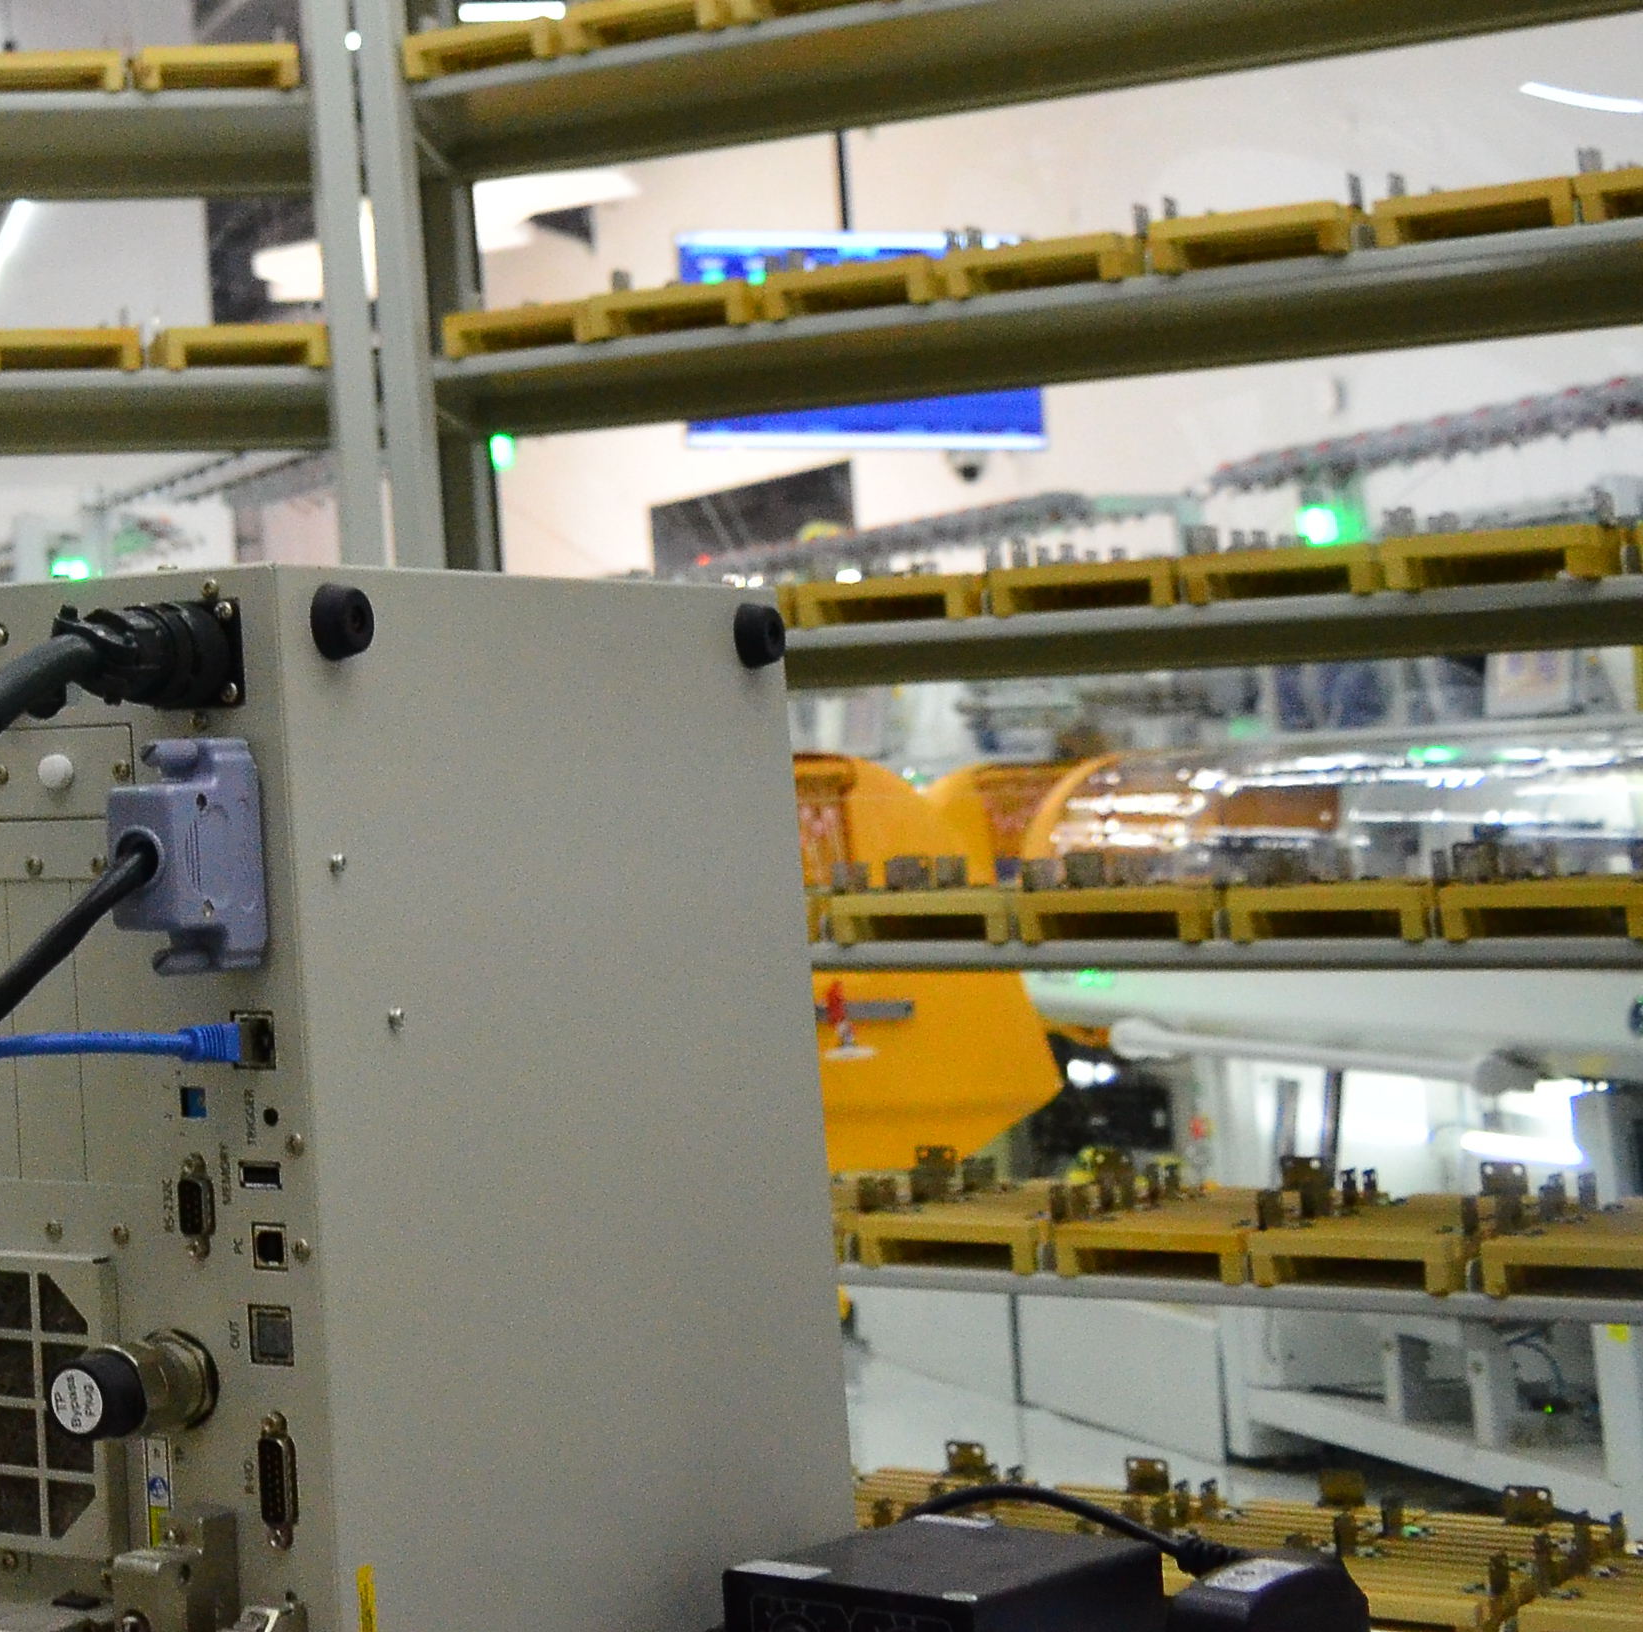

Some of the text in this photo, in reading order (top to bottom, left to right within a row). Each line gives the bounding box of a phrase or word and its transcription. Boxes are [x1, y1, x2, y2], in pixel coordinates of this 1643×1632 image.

[244, 1089, 257, 1145] TRIGGER
[218, 1142, 231, 1206] MEMORY
[162, 1178, 175, 1235] RS-232C
[233, 1236, 244, 1256] PC
[227, 1320, 240, 1349] OUT
[54, 1391, 67, 1412] TP
[66, 1374, 83, 1428] Bypass
[84, 1384, 96, 1417] Plug
